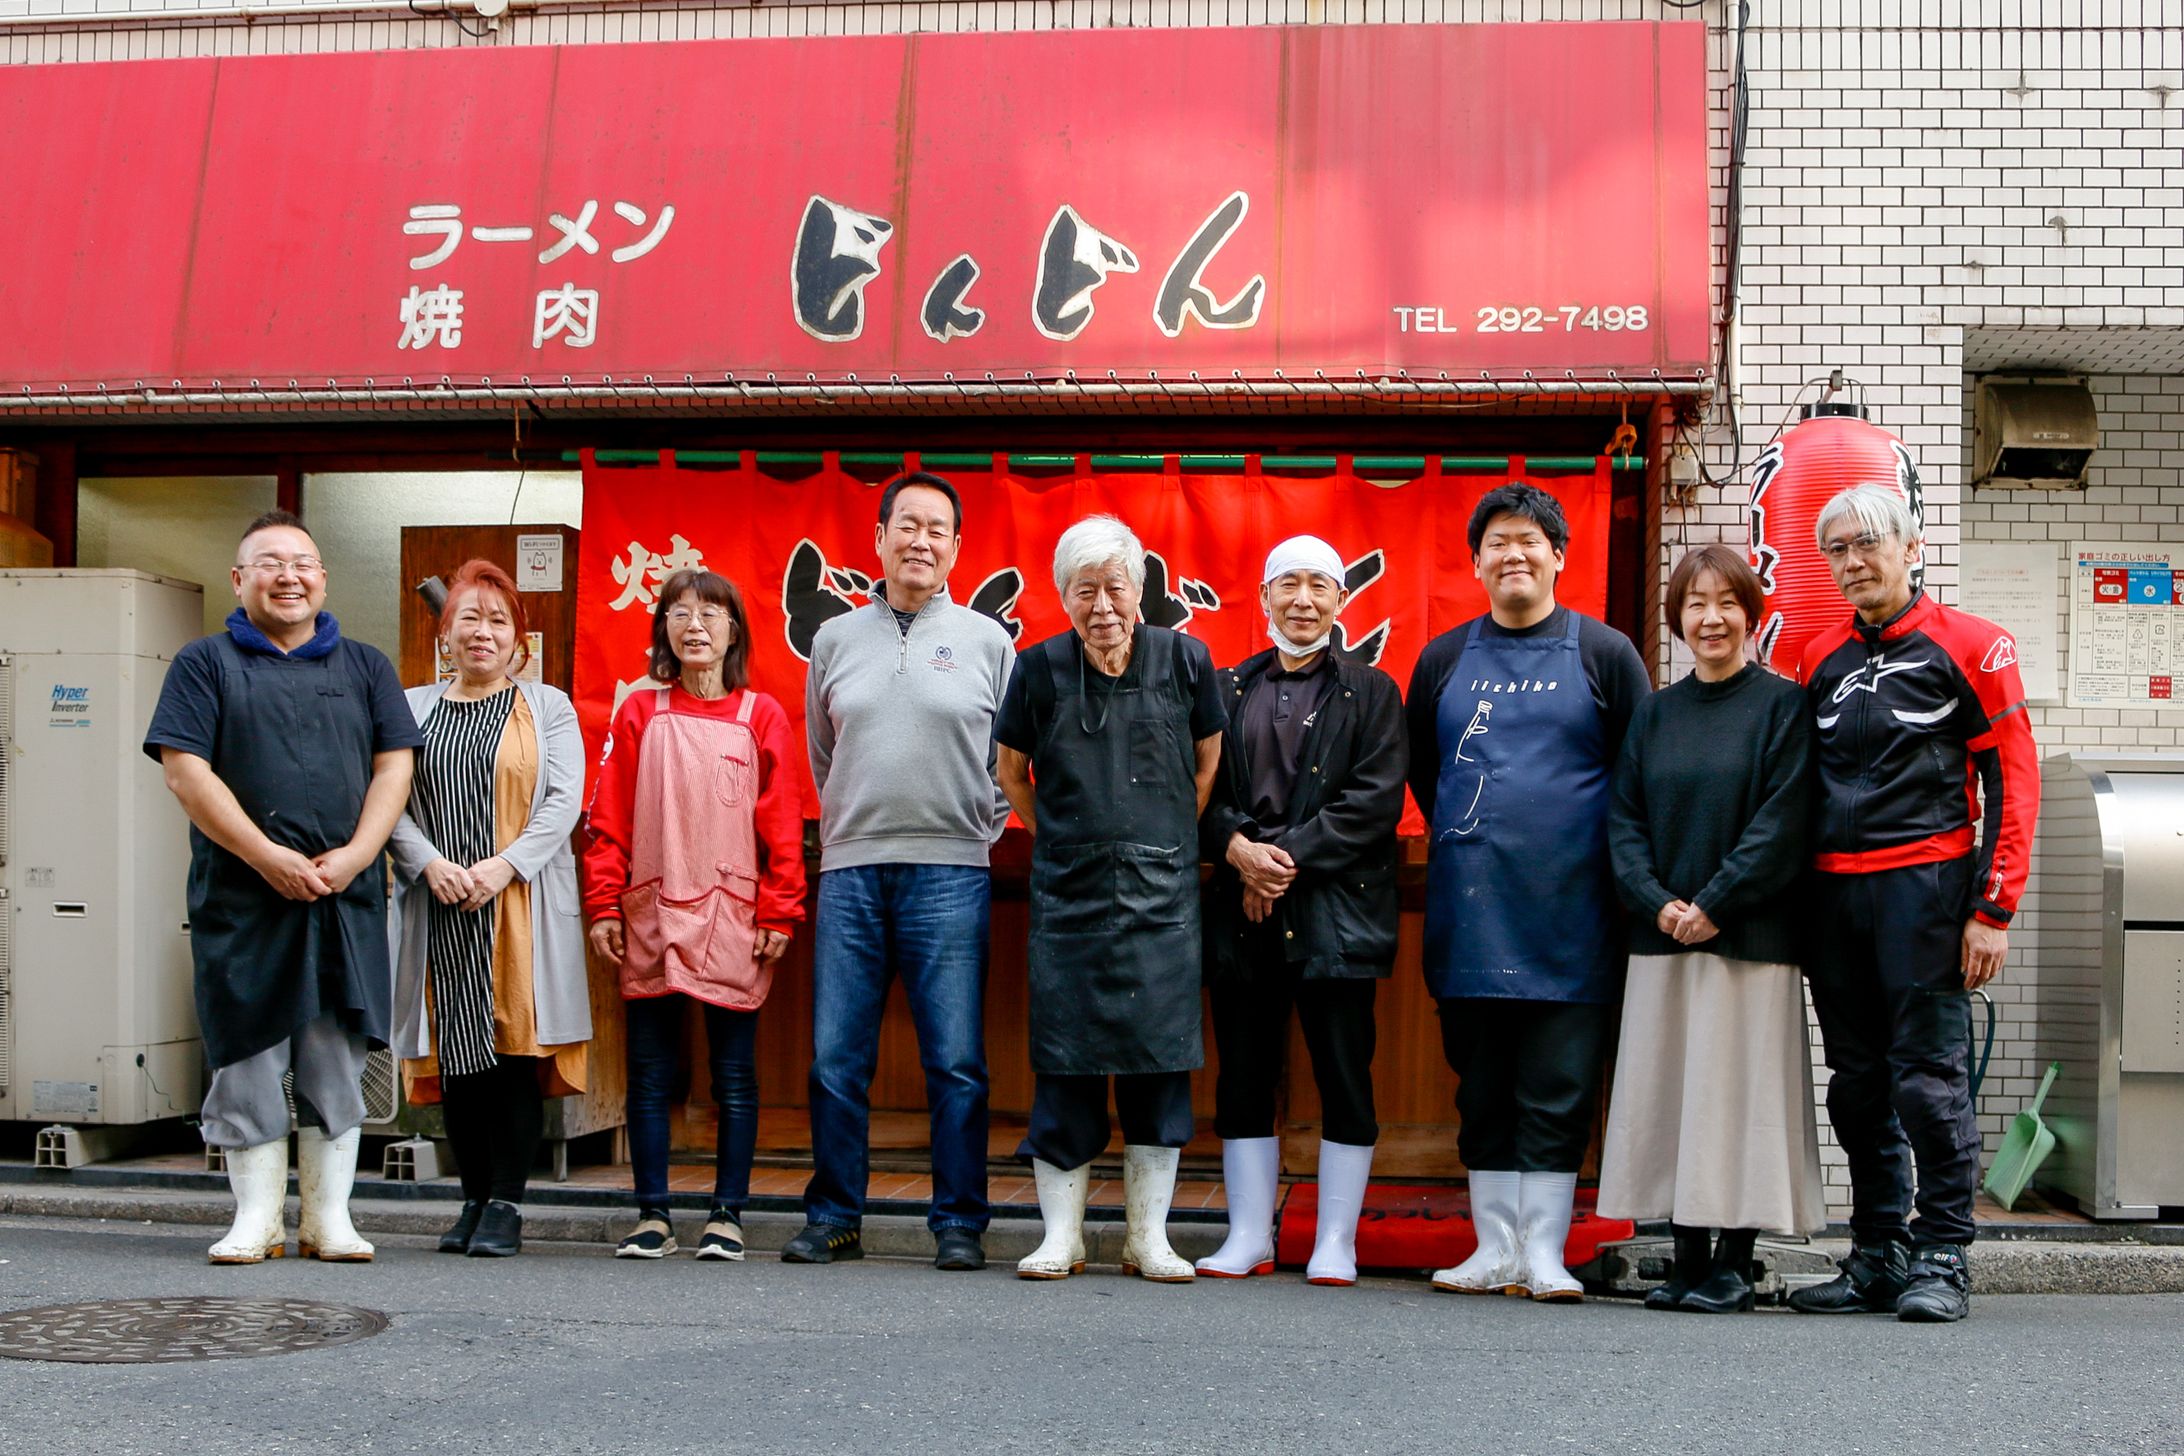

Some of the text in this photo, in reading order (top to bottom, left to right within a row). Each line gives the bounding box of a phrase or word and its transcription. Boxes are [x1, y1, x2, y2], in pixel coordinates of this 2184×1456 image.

[402, 199, 675, 270] ラーメン
[791, 190, 1266, 342] どんどん
[397, 281, 599, 349] 焼肉
[1392, 305, 1649, 333] TEL 292-7498
[51, 684, 89, 701] Hyper
[51, 700, 90, 713] Inverter
